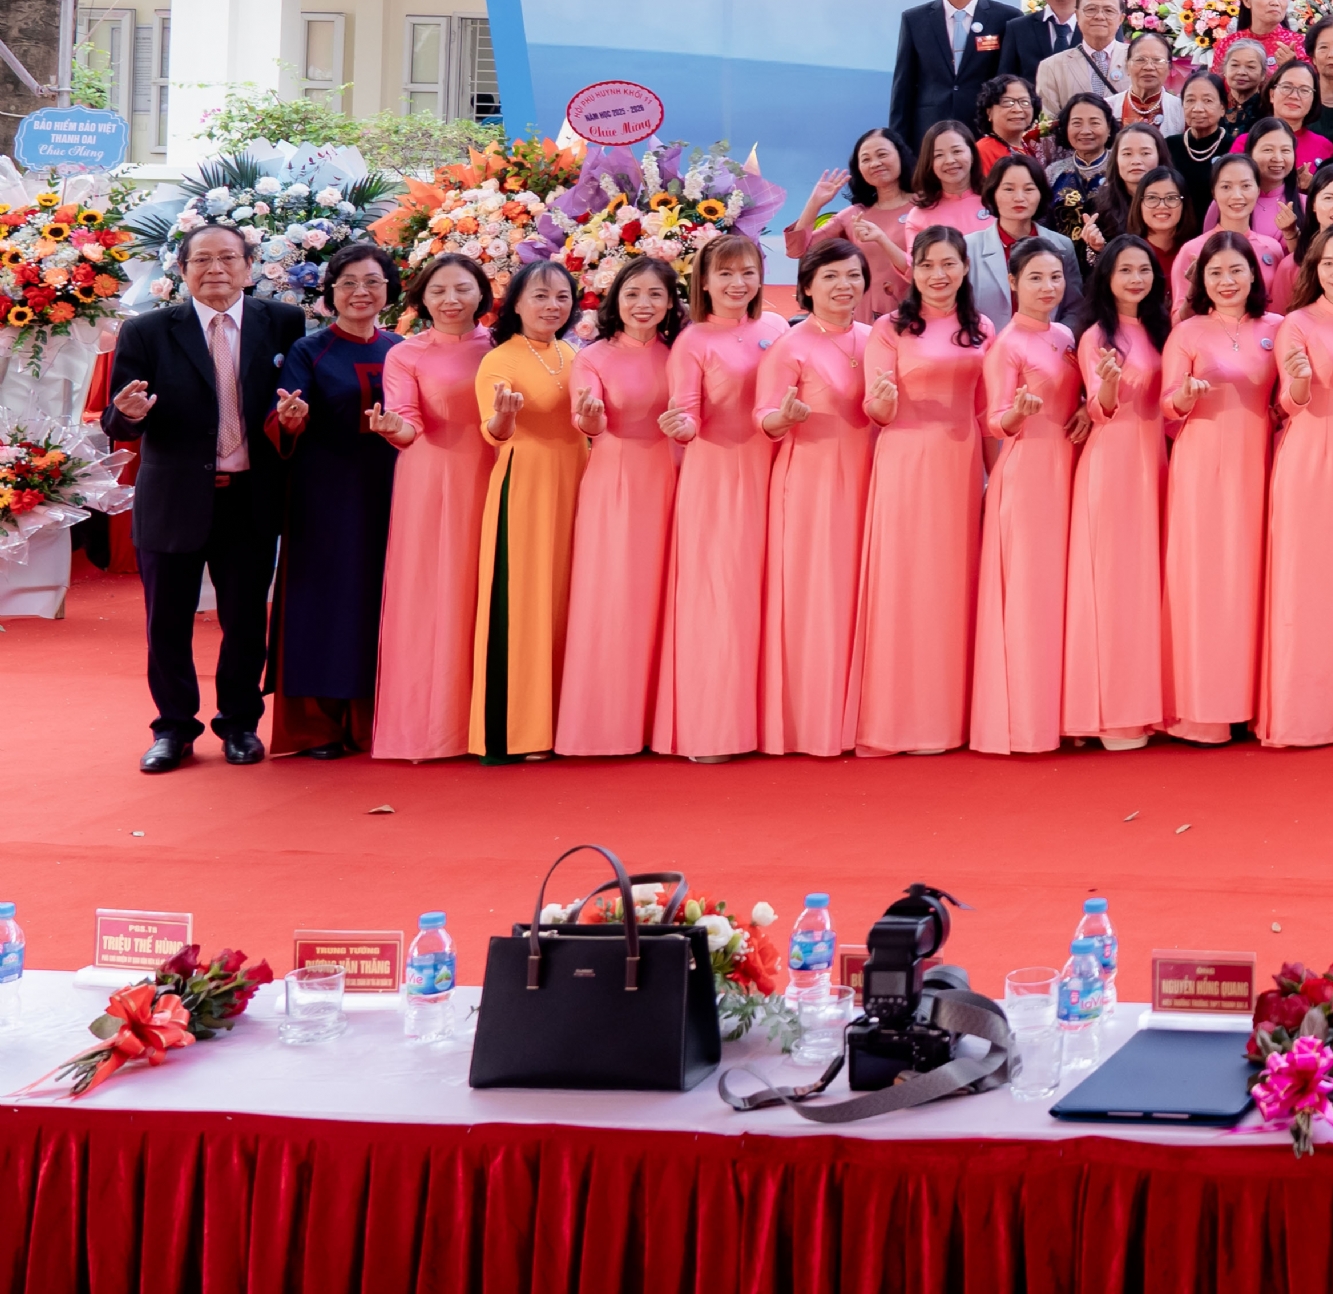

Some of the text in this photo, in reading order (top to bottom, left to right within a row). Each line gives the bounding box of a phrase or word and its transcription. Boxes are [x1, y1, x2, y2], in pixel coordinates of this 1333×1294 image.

[581, 96, 595, 107] PHỤ
[595, 88, 621, 98] HUYNH
[624, 88, 643, 99] KHỐI
[644, 97, 653, 105] 11
[584, 112, 599, 121] NĂM
[599, 110, 612, 119] HỌC
[612, 108, 626, 116] 2025
[630, 105, 645, 113] 2026
[33, 118, 117, 134] BẢO HIỂM BẢO VIỆT
[589, 119, 651, 137] Chúc Mừng
[51, 134, 96, 144] THANH OAI
[38, 144, 65, 156] Chúc
[102, 934, 131, 954] TRIỆU
[134, 935, 153, 953] THẾ
[1162, 975, 1195, 995] NGUYỄN
[1221, 981, 1249, 997] QUANG
